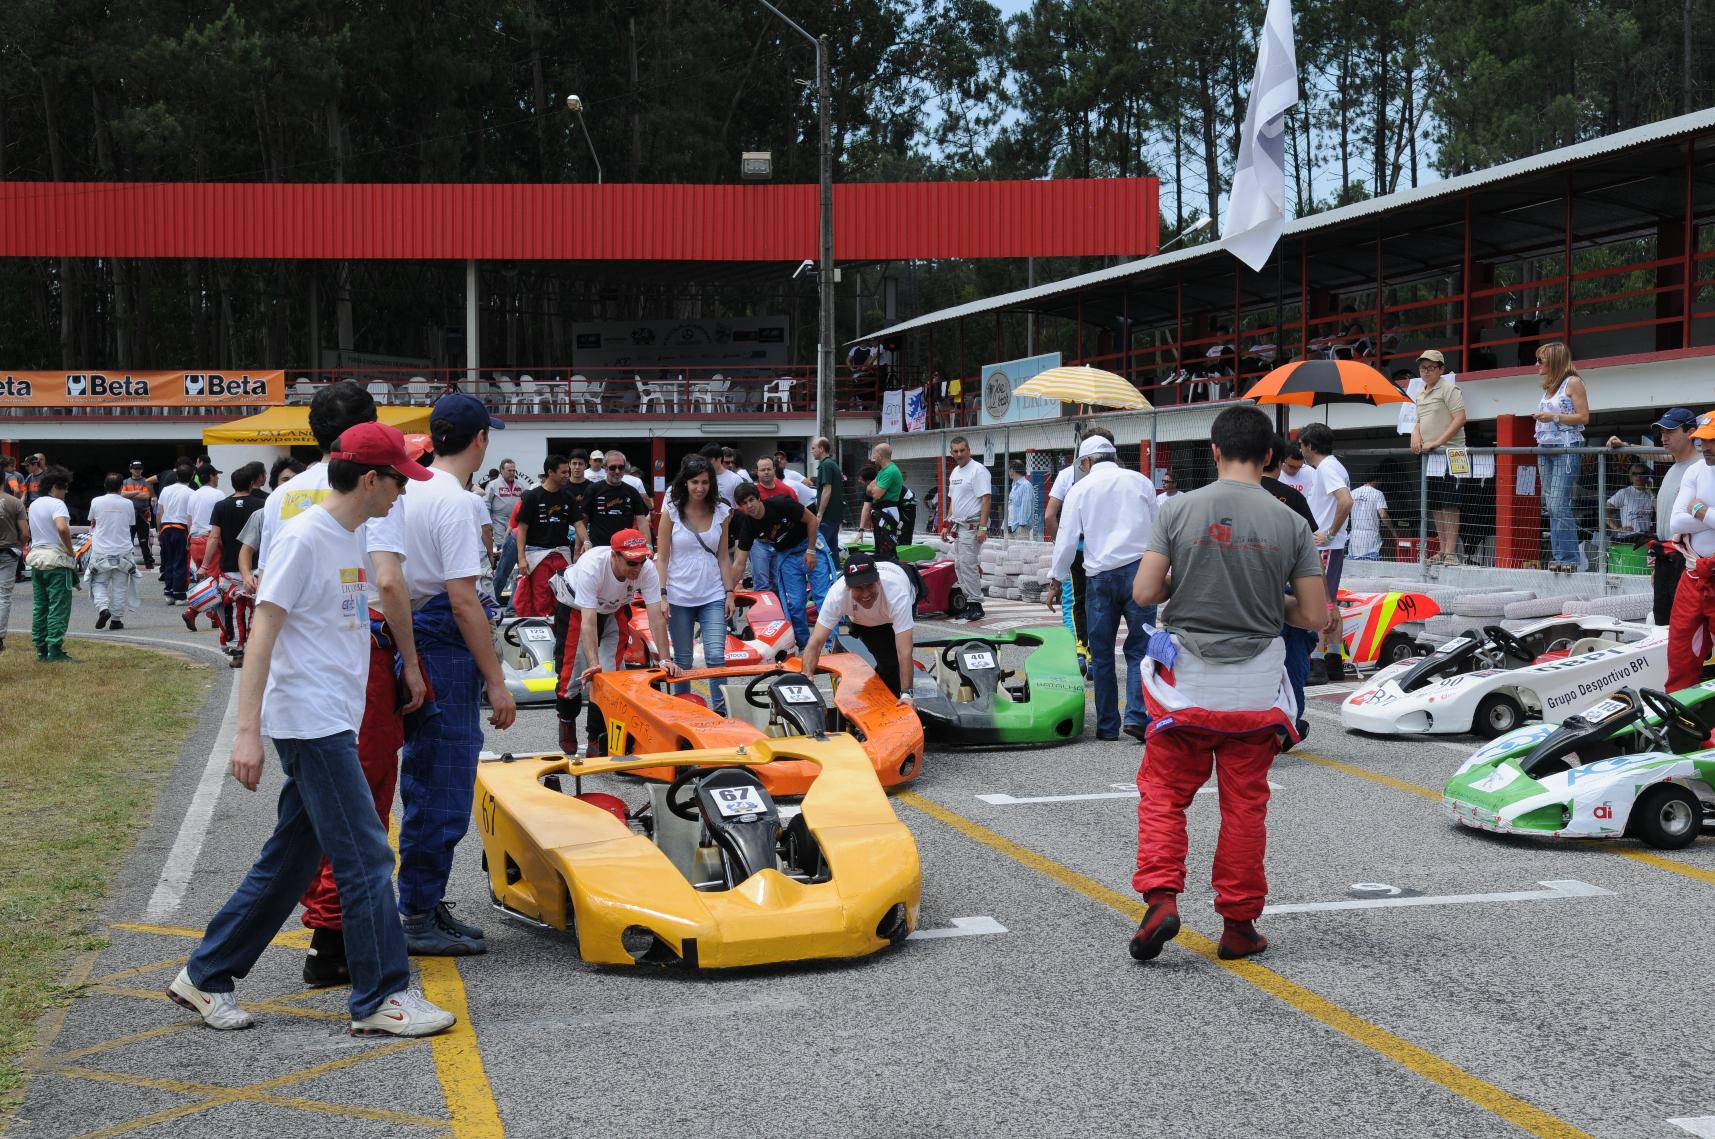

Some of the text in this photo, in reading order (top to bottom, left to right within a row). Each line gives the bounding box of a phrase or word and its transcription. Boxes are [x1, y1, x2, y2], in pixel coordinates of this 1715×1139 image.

[90, 375, 149, 396] Beta
[207, 374, 268, 396] Beta
[1397, 594, 1417, 619] 99
[785, 686, 802, 695] 17
[1547, 656, 1650, 710] Grupo Desportivo BPI
[609, 721, 622, 751] 17
[719, 787, 749, 802] 67
[482, 790, 496, 837] 67
